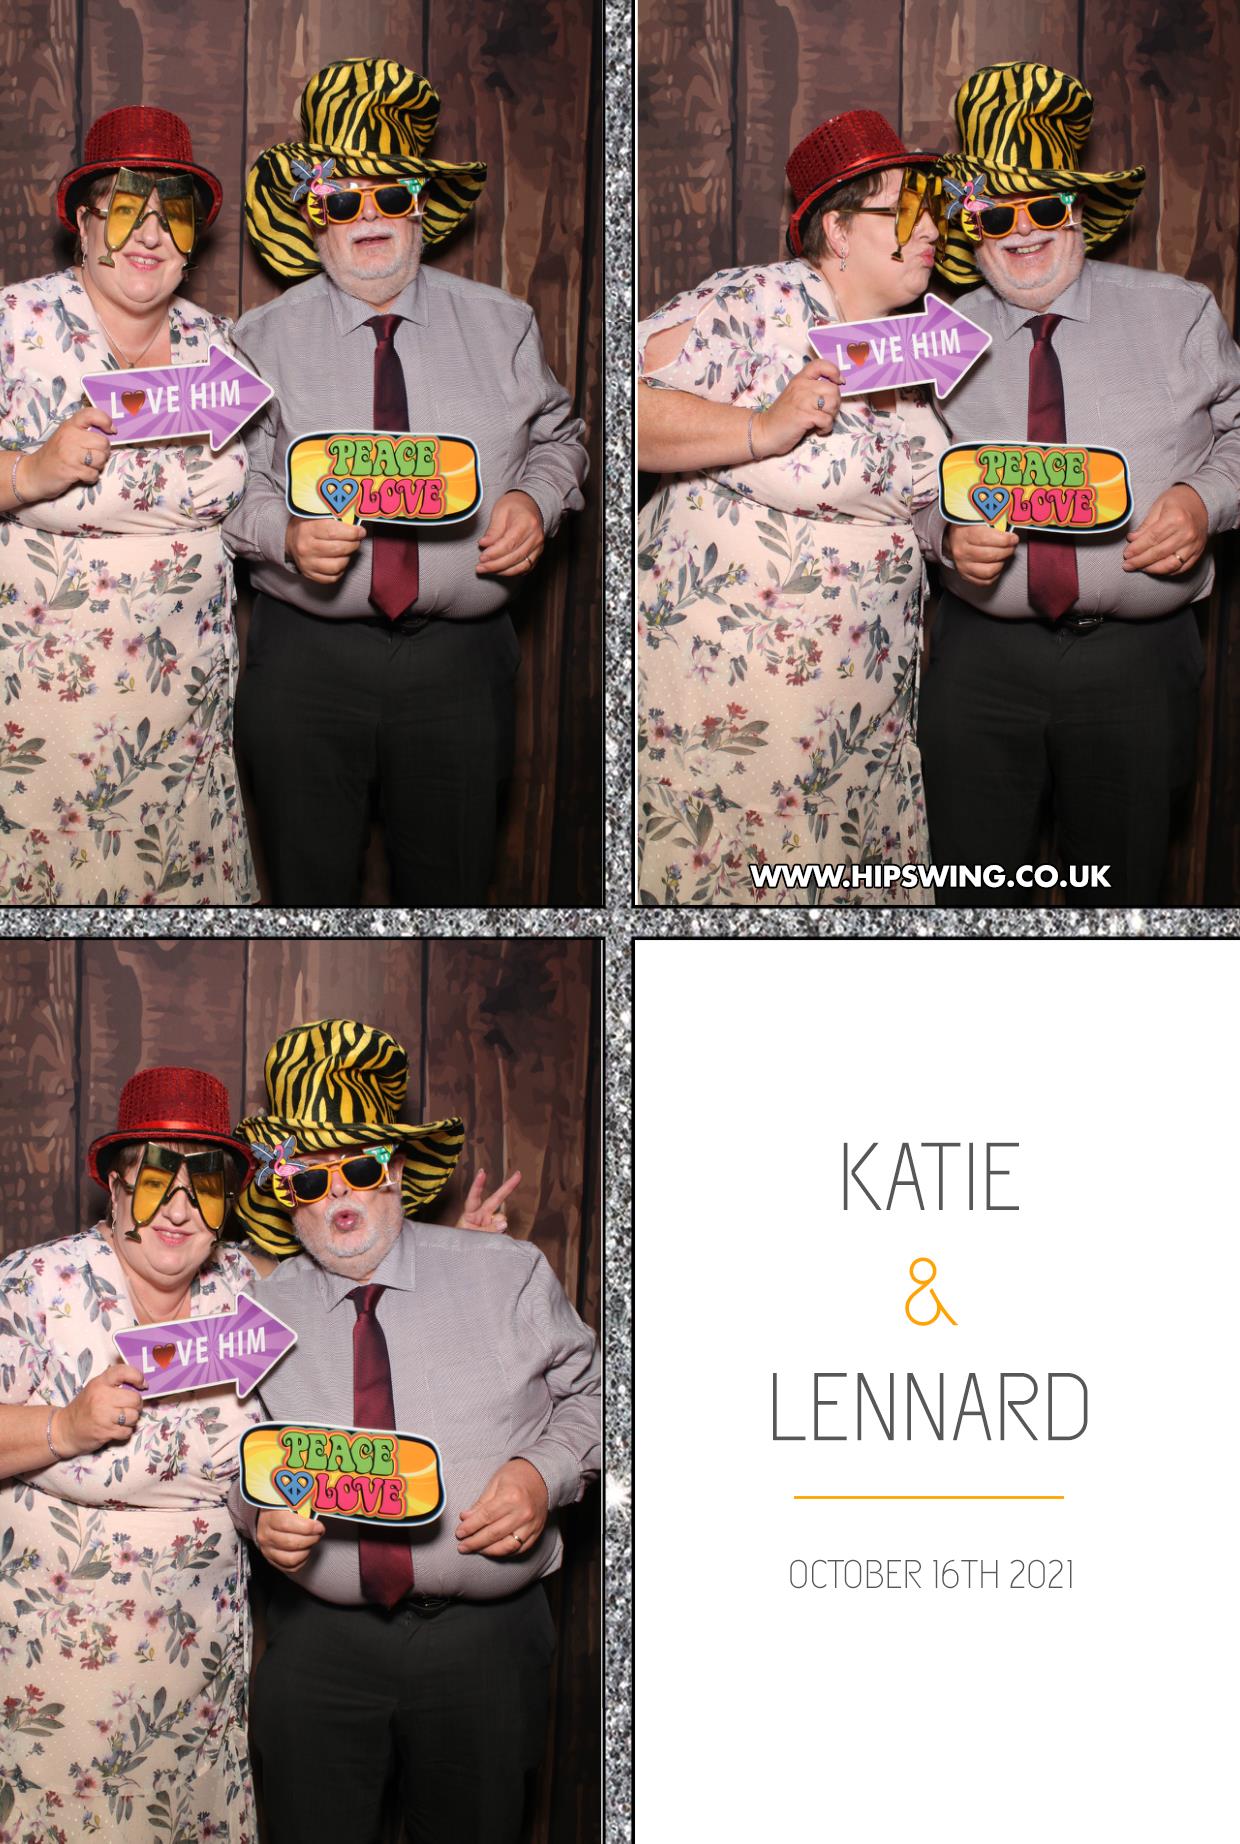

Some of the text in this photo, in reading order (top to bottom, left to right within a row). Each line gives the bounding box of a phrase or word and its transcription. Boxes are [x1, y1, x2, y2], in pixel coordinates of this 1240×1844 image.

[911, 327, 961, 360] HIM
[190, 379, 241, 410] HIM
[329, 439, 436, 477] PEACE
[979, 450, 1085, 486] PEACE
[359, 478, 442, 515] LOVE
[1011, 487, 1093, 524] LOVE
[218, 1326, 266, 1360] HIM
[281, 1431, 395, 1476] PEACE
[315, 1473, 403, 1515] LOVE
